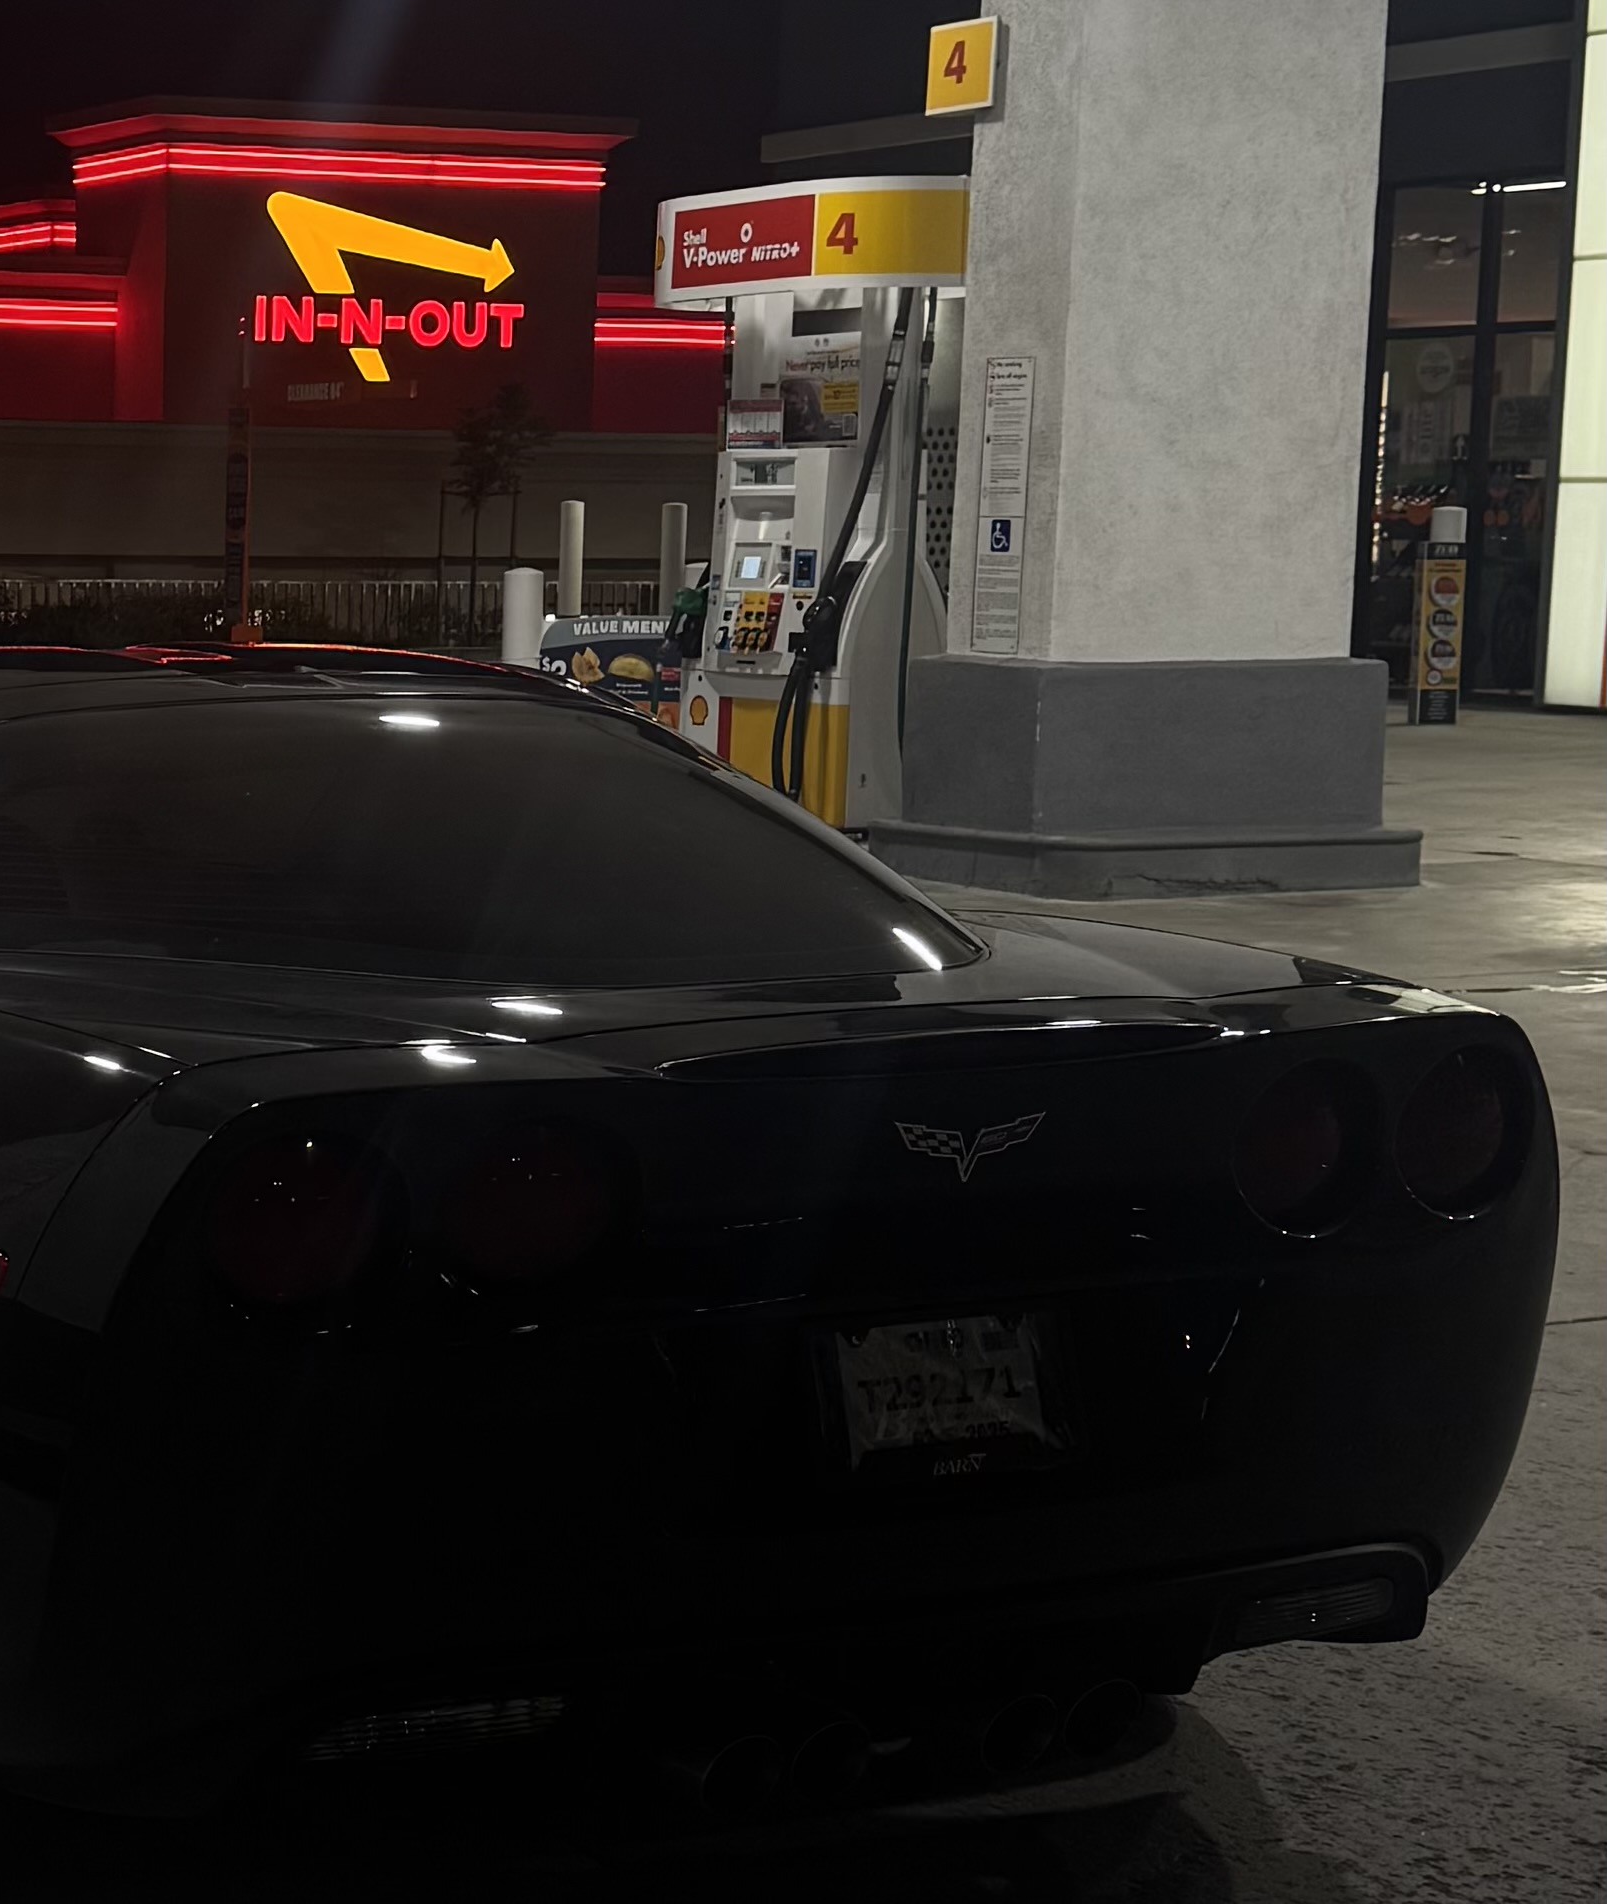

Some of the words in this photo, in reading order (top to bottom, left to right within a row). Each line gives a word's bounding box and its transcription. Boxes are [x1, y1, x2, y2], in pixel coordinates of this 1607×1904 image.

[943, 40, 967, 84] 4
[683, 228, 707, 246] Shell
[826, 213, 858, 255] 4
[683, 248, 746, 268] V-Power
[254, 295, 525, 348] IN-N-OUT
[574, 621, 618, 636] VALUE
[622, 620, 670, 634] MEN
